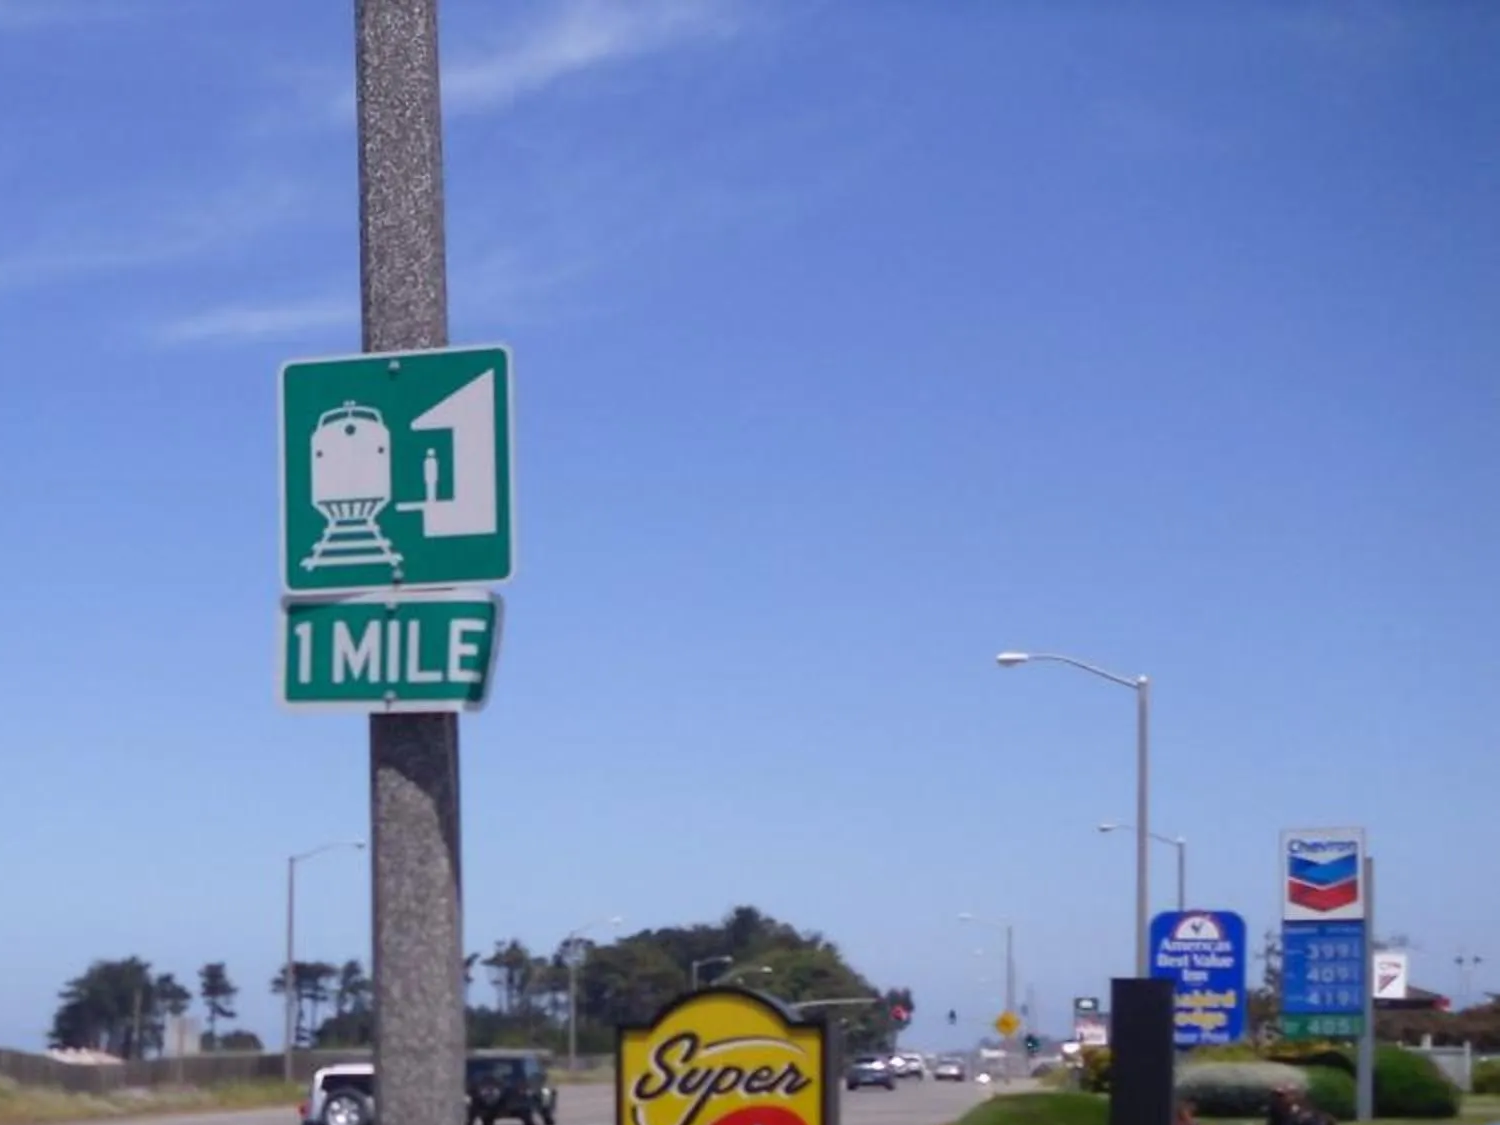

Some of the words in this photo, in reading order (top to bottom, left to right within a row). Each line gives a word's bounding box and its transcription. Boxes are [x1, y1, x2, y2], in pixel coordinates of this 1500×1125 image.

[295, 620, 314, 684] 1
[332, 619, 487, 684] MILE
[1287, 839, 1358, 854] Chevron
[1157, 953, 1189, 968] Best
[1193, 952, 1235, 968] Value
[1182, 969, 1208, 982] Inn
